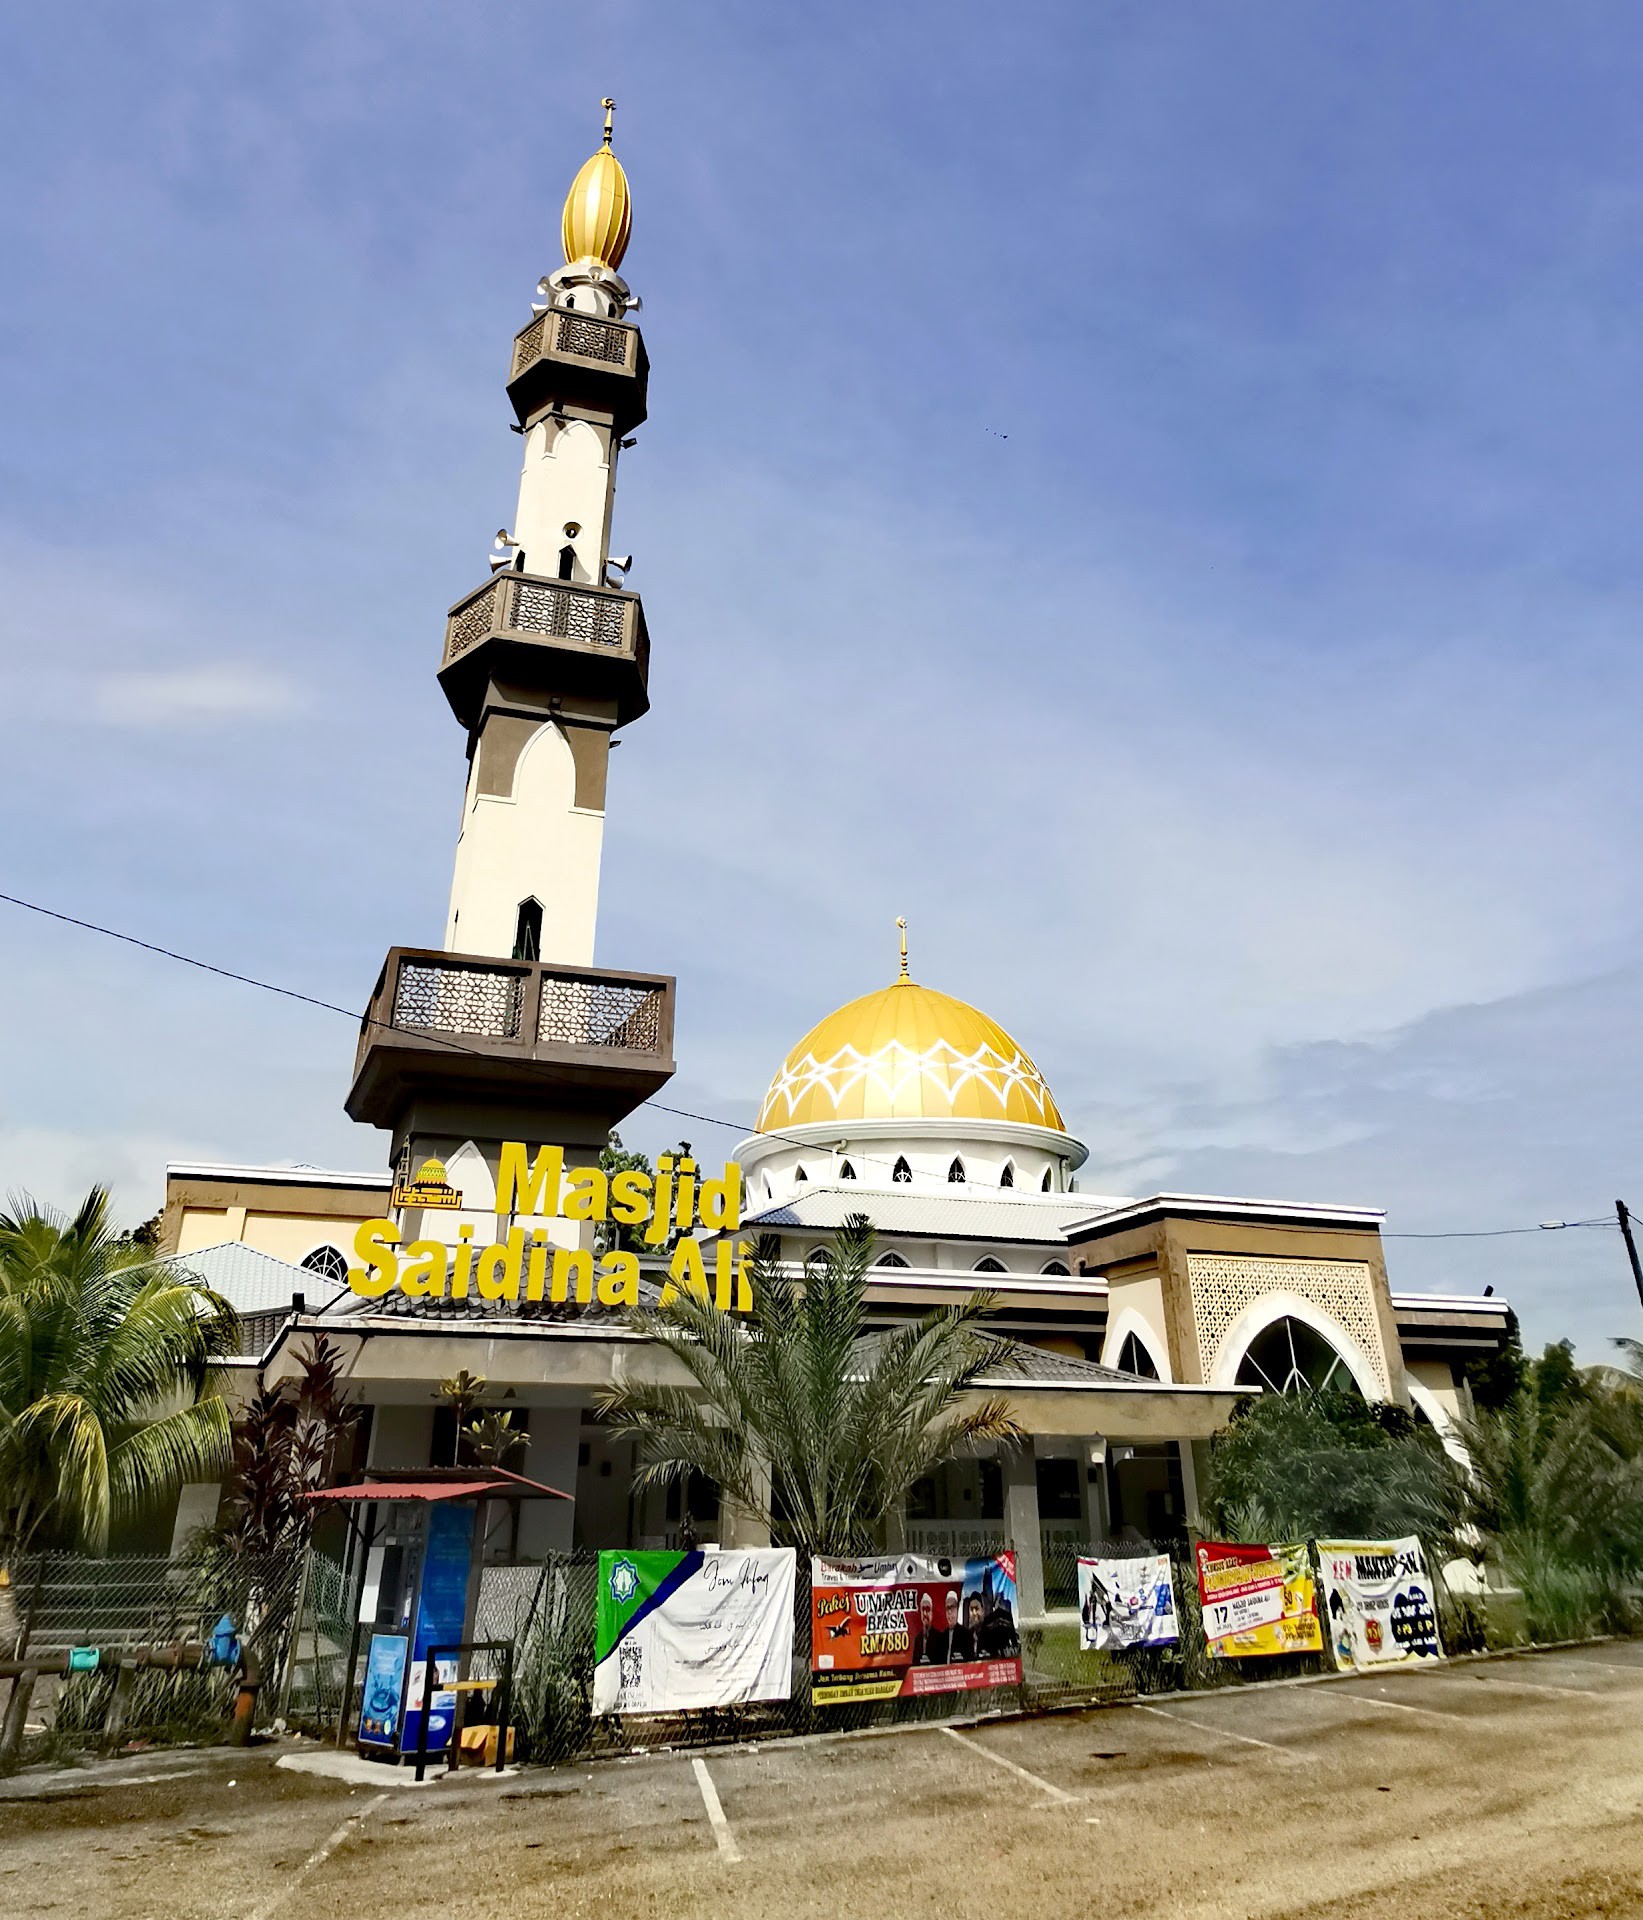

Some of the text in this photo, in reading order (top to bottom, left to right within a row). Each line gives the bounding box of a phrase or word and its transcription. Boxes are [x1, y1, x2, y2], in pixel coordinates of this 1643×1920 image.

[494, 1141, 741, 1245] Masjid
[347, 1217, 754, 1312] Saidina Ali
[817, 1592, 851, 1617] Pakej
[854, 1589, 918, 1614] UMRAH
[866, 1610, 908, 1633] BIASA
[1214, 1606, 1228, 1624] 17
[859, 1632, 910, 1655] RM7880
